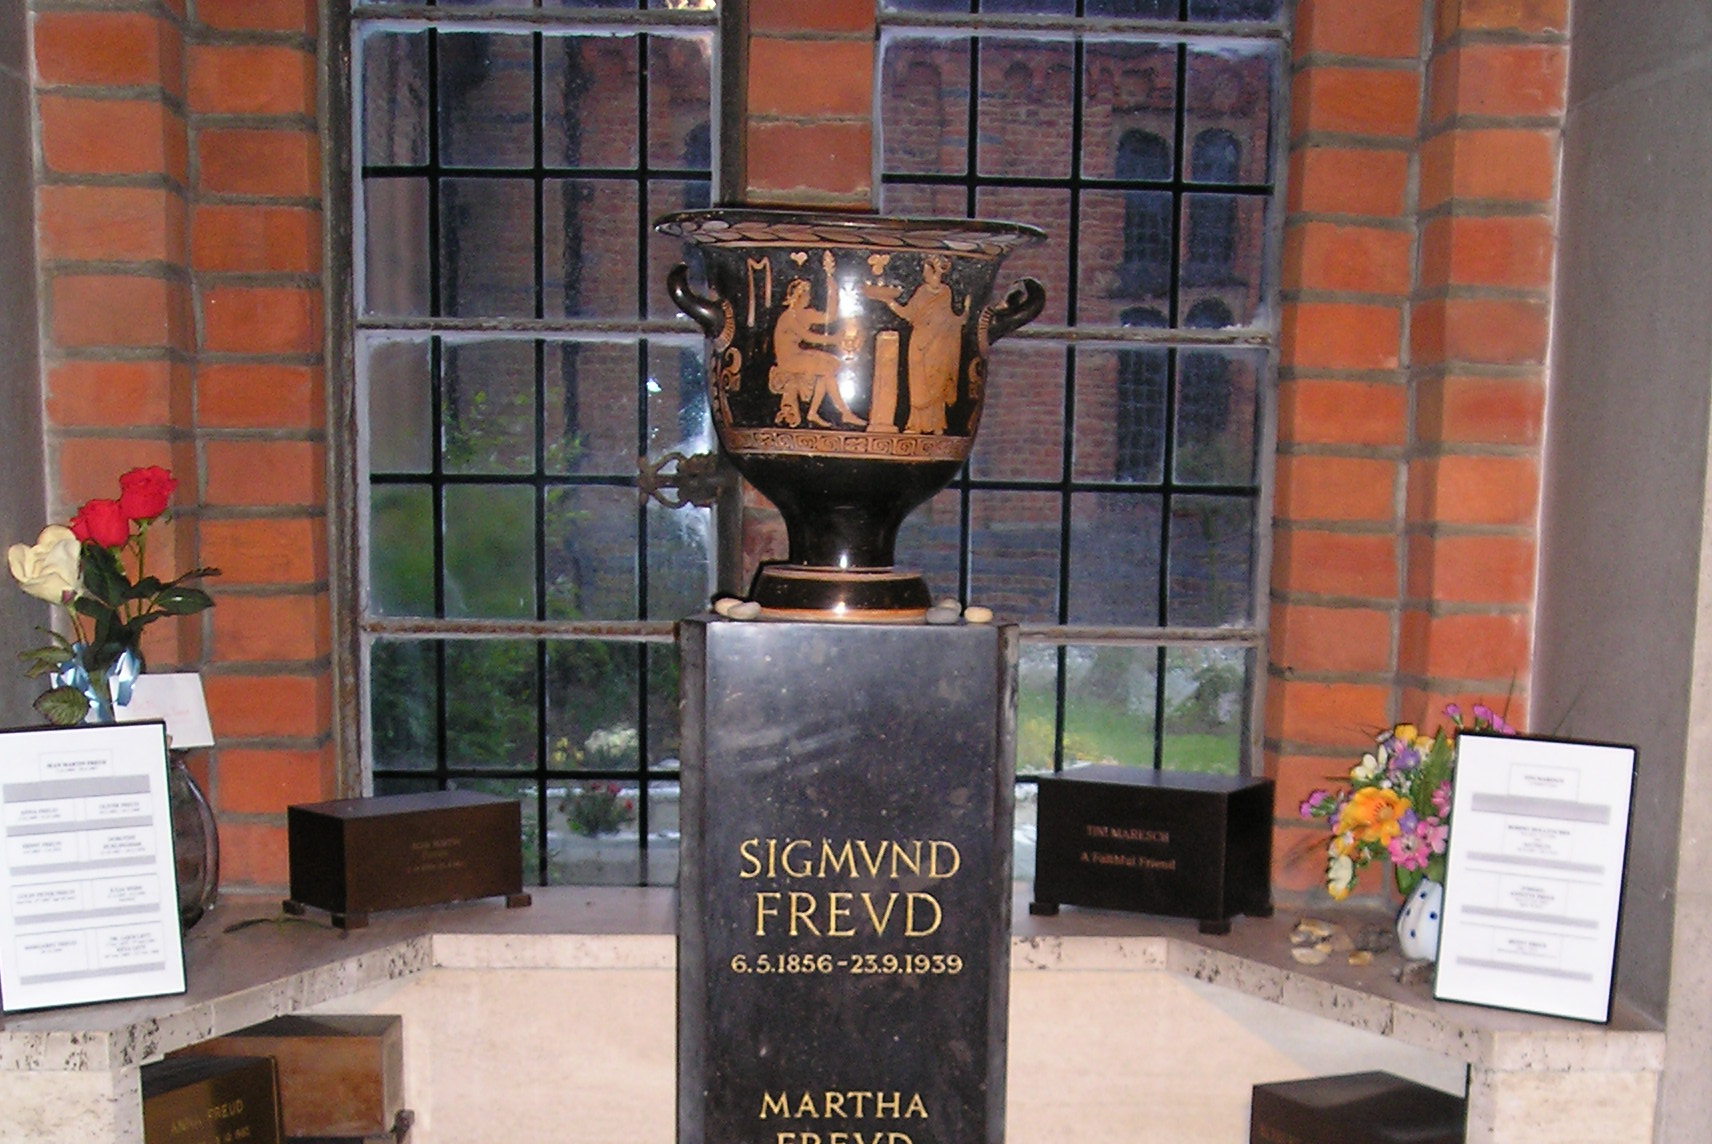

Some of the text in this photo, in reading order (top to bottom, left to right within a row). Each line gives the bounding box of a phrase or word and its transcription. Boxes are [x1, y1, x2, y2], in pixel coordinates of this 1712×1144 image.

[739, 837, 962, 880] SIGMVND
[754, 891, 943, 938] FREVD
[758, 1090, 929, 1120] MARTHA
